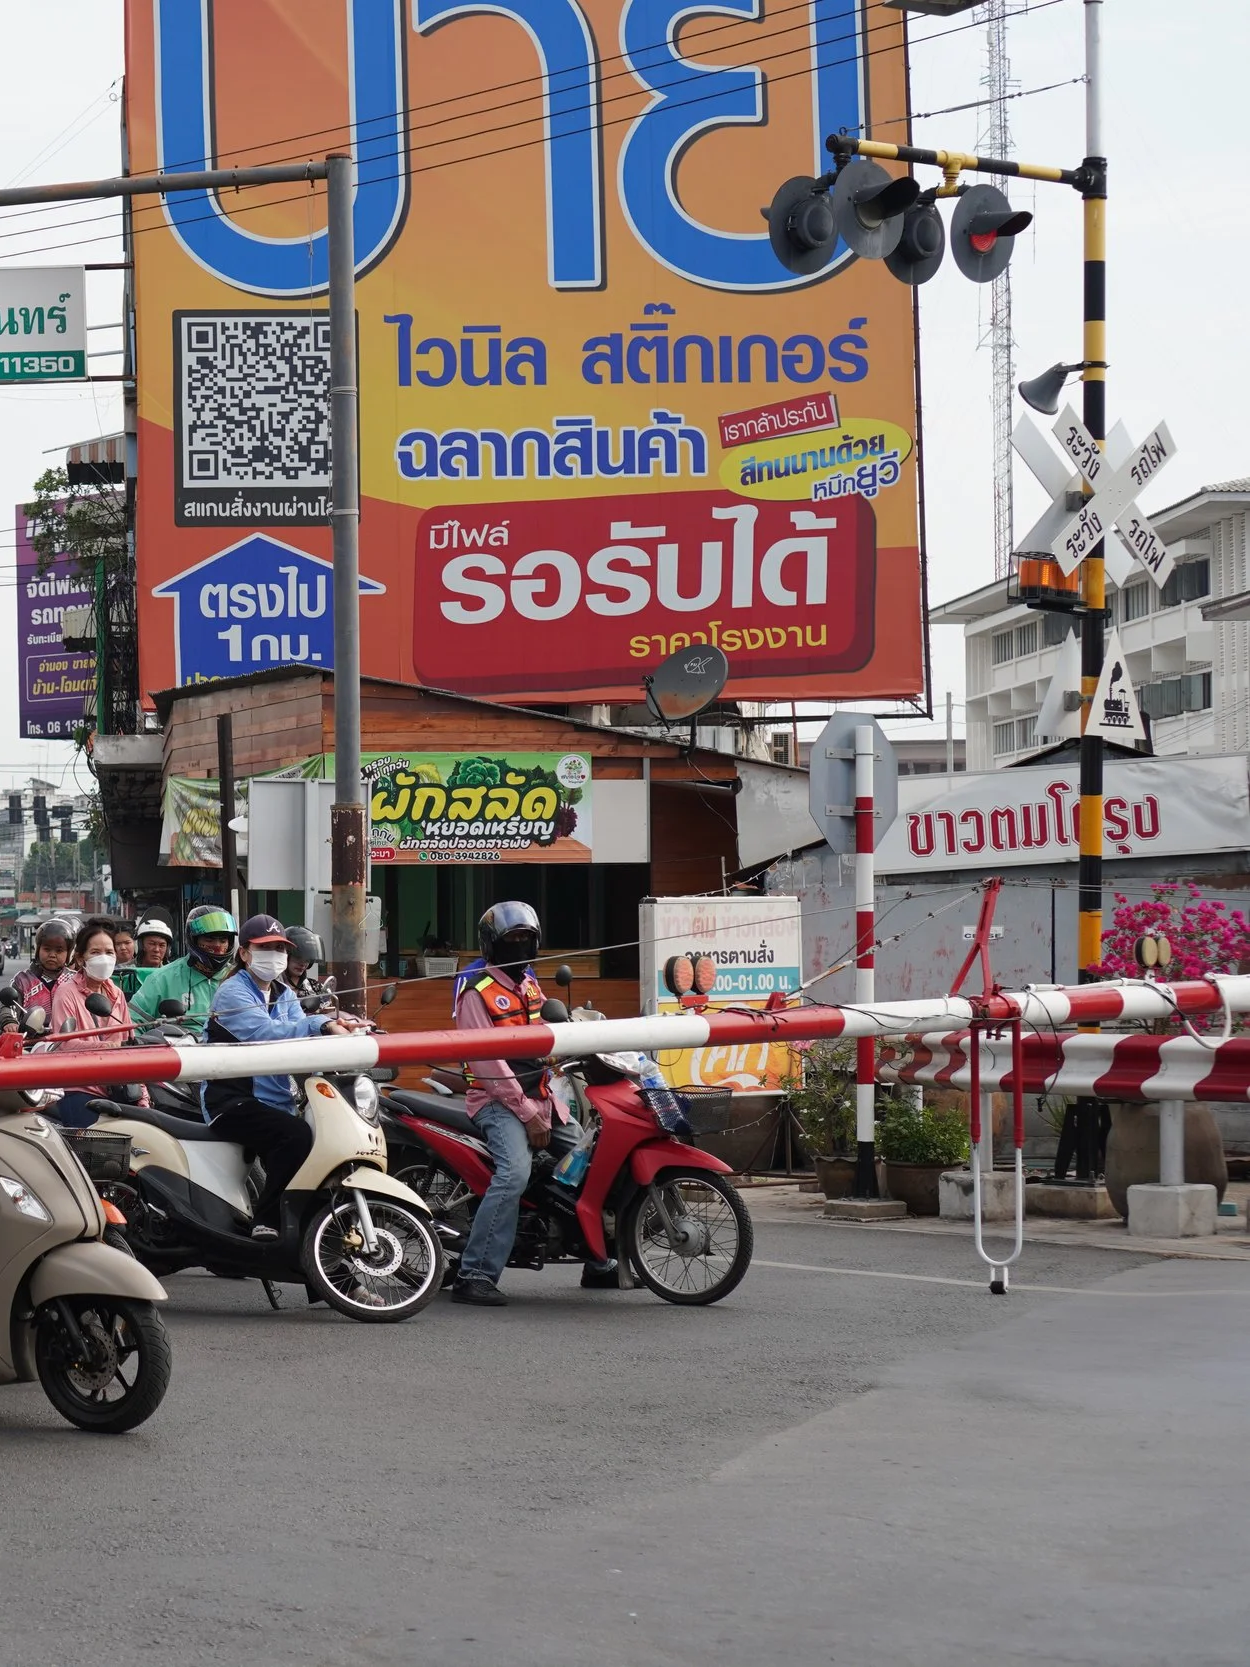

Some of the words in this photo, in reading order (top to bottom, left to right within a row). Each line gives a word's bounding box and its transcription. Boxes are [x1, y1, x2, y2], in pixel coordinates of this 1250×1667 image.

[383, 313, 548, 388] ไวนิล
[581, 303, 870, 385] สติ๊กเกอร์
[396, 410, 707, 478] ฉลากสินค้า
[723, 401, 828, 442] เรากล้าประกัน
[740, 434, 885, 486] สีทนนานด้วย
[1065, 426, 1101, 481] ระวัง
[1128, 519, 1166, 573] รถไฟ
[1066, 508, 1103, 558] ระวัง
[1130, 431, 1167, 485] รถไฟ
[429, 519, 510, 549] มีไฟล์
[439, 504, 838, 626] รอรับได้
[199, 566, 327, 619] ตรงไป
[628, 620, 828, 658] ราคาโรงงาน
[47, 721, 61, 734] 06
[370, 772, 558, 821] ผักสลัด
[429, 851, 501, 862] 080-3942826
